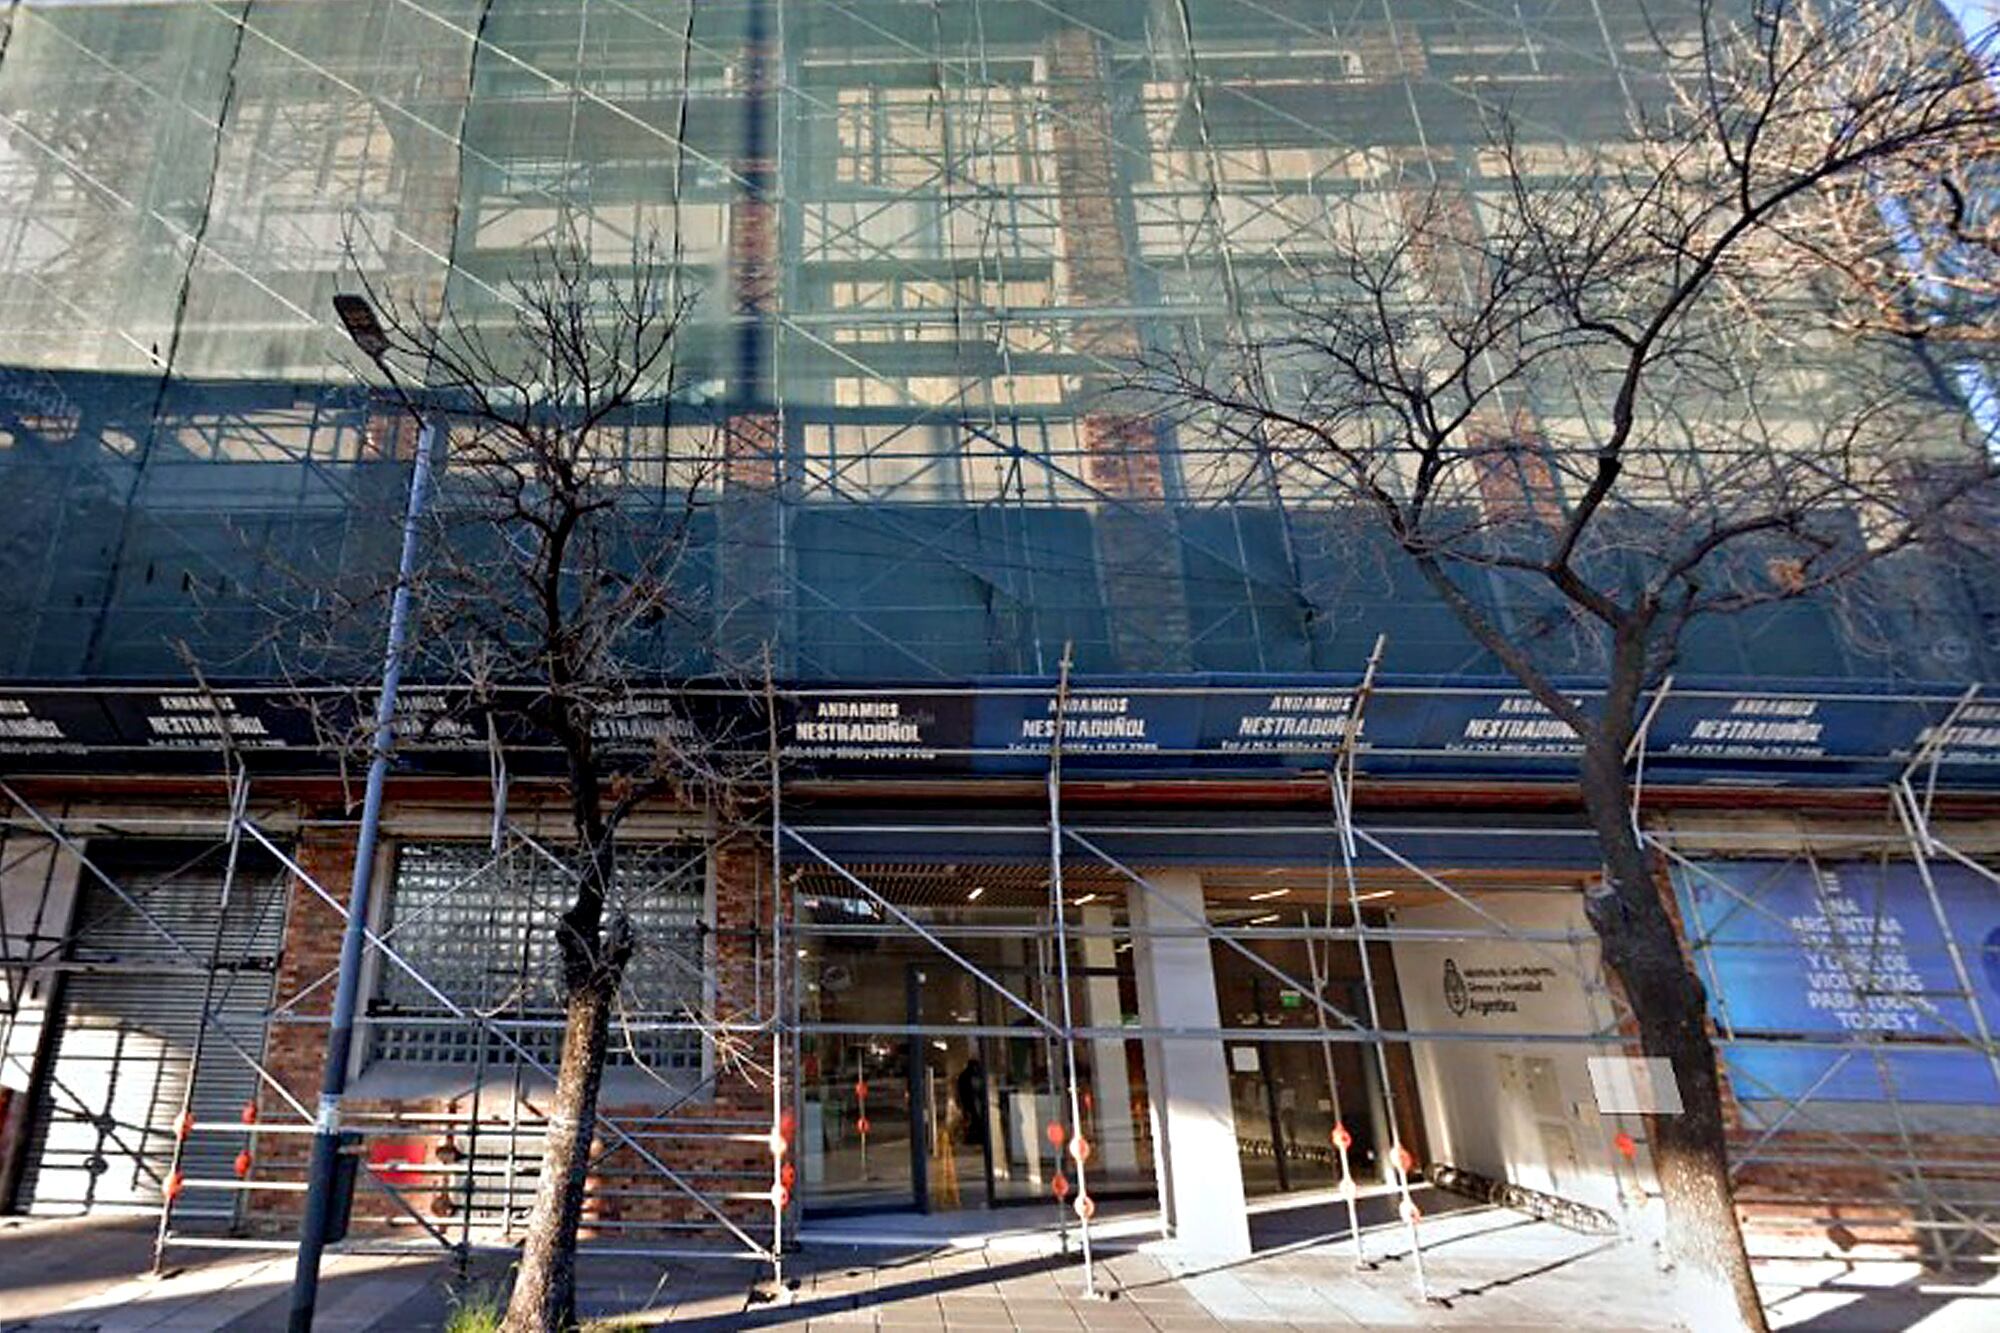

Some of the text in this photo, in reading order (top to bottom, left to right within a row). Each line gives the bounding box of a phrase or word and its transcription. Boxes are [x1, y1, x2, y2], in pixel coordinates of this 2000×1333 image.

[817, 701, 900, 718] ANDAMIOS
[1268, 695, 1353, 712] ANDAMIOS
[795, 719, 923, 743] NESTRADUÑOL
[1237, 713, 1366, 736] NESTRADUÑL
